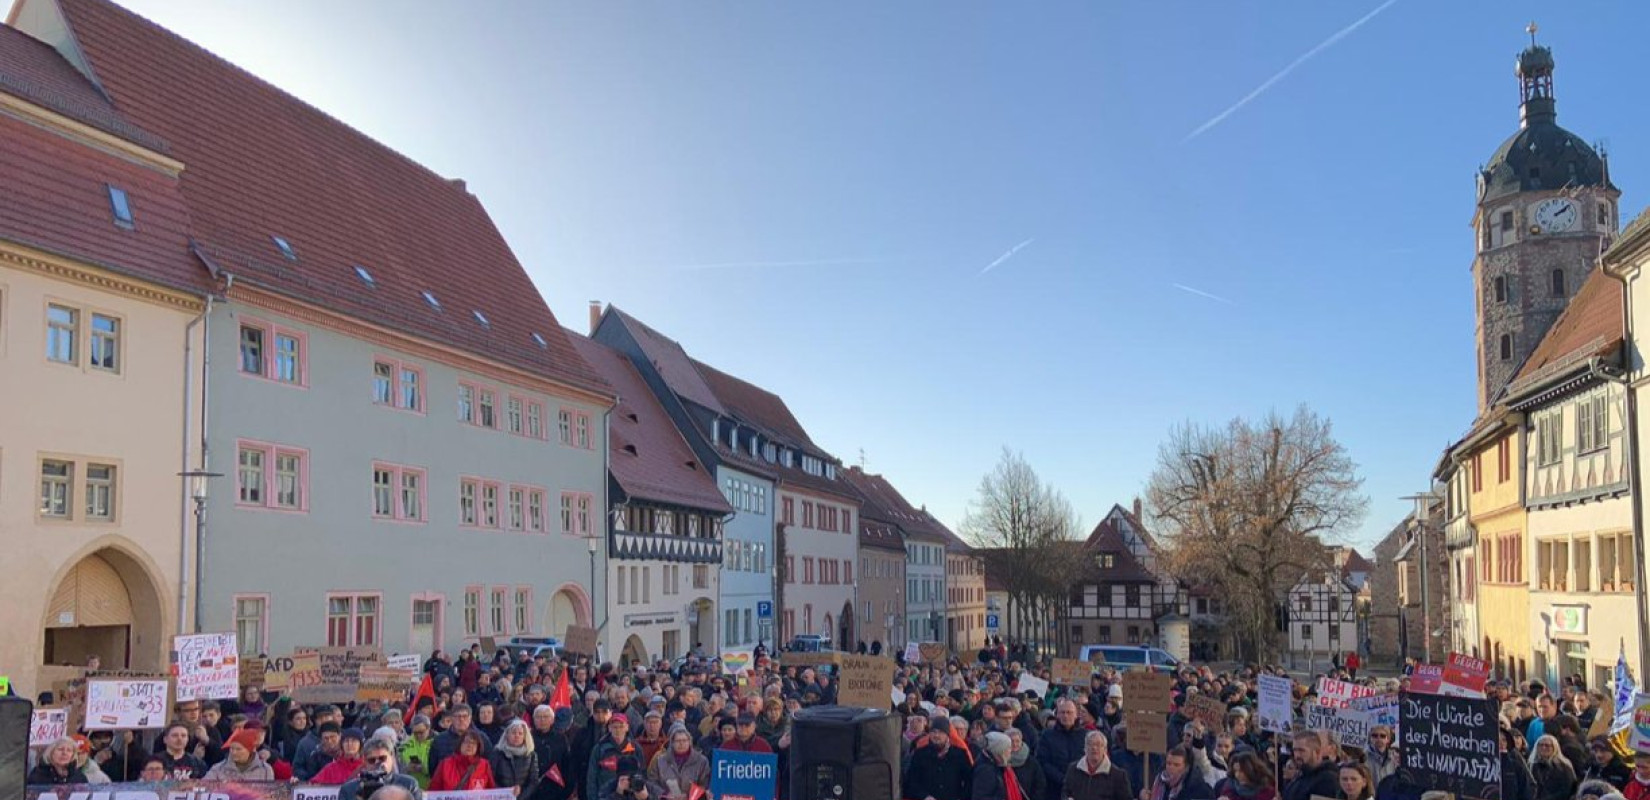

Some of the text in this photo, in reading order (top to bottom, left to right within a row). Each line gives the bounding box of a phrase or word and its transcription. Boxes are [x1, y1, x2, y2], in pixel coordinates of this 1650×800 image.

[761, 603, 768, 614] P
[264, 657, 294, 674] AfD
[1418, 664, 1442, 676] GEGEN
[1453, 655, 1484, 672] GEGEN
[290, 669, 322, 688] 1933
[1323, 679, 1345, 695] ICH
[130, 683, 155, 697] STATT
[1406, 699, 1431, 719] Die
[1436, 701, 1485, 727] Würde
[1405, 722, 1495, 756] des Menschen
[1405, 747, 1425, 769] ist
[718, 759, 771, 779] Frieden
